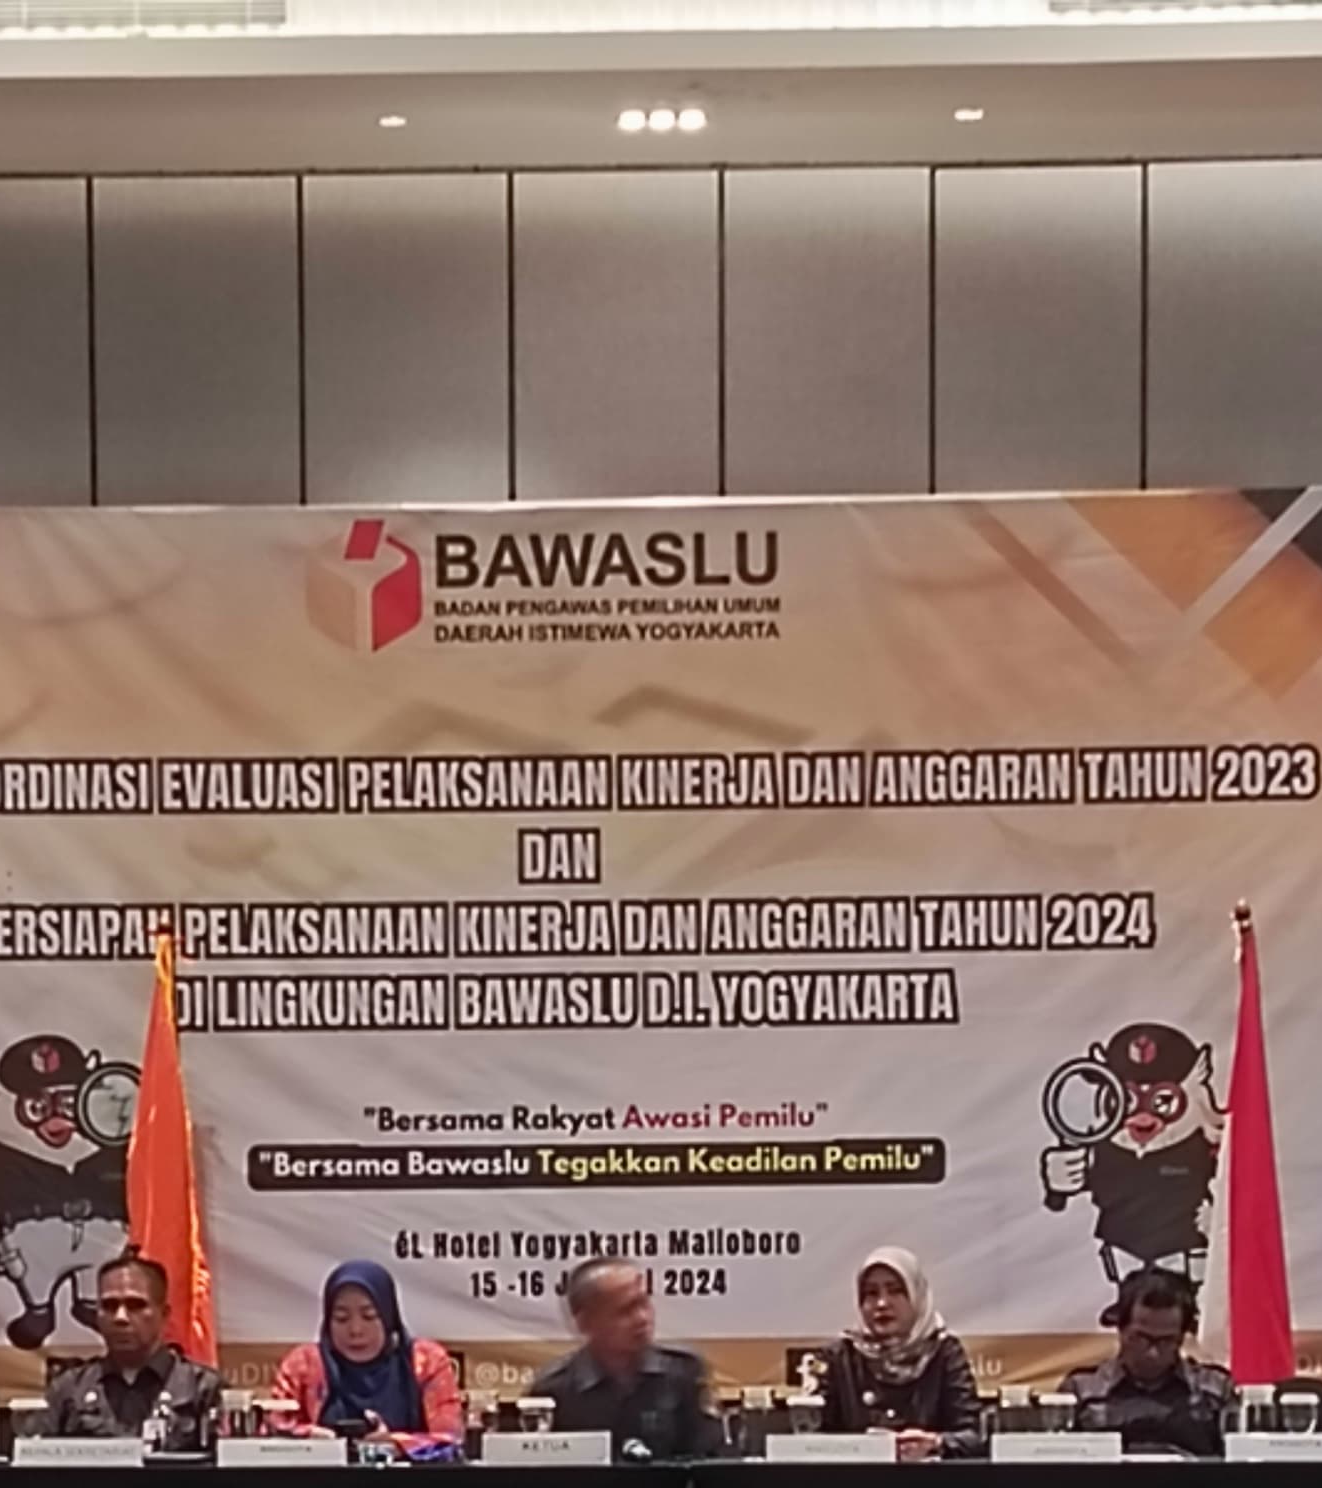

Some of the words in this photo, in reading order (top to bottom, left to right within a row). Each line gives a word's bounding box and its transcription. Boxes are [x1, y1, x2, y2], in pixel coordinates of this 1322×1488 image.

[435, 530, 778, 588] BAWASLU
[434, 600, 500, 617] BADAN
[506, 599, 611, 616] PENGAWAS
[617, 598, 719, 615] PEMILIHAN
[725, 596, 781, 614] UMUM
[434, 624, 523, 643] DAERAH
[528, 622, 632, 642] ISTIMEWA
[636, 621, 781, 641] YOGYAKARTA
[161, 760, 336, 811] EVALUASI
[346, 757, 609, 809] PELAKSANAAN
[620, 755, 776, 807] KINERJA
[786, 753, 862, 806] DAN
[874, 751, 1072, 804] ANGGARAN
[1083, 749, 1205, 800] TAHUN
[1214, 747, 1318, 799] 2023
[521, 830, 598, 881] DAN
[183, 904, 447, 957] PELAKSANAAN
[456, 901, 614, 955] KINERJA
[622, 900, 698, 953] DAN
[708, 898, 909, 952] ANGGARAN
[917, 897, 1040, 949] TAHUN
[1047, 895, 1154, 947] 2024
[215, 976, 447, 1028] LINGKUNGAN
[457, 974, 637, 1026] BAWASLU
[711, 969, 957, 1023] YOGYAKARTA
[364, 1106, 504, 1132] "Bersama
[512, 1104, 615, 1136] Rakyat
[622, 1103, 711, 1130] Awasi
[719, 1102, 828, 1128] Pemilu"
[259, 1151, 400, 1177] "Bersama
[407, 1149, 529, 1176] Bawaslu
[536, 1148, 680, 1181] Tegakkan
[687, 1146, 817, 1173] Keadilan
[824, 1144, 934, 1171] Pemilu"
[433, 1231, 500, 1259] Hotel
[511, 1230, 658, 1260] Yogyakarta
[668, 1228, 801, 1256] Malioboro
[470, 1271, 497, 1298] 15
[664, 1269, 726, 1296] 2024
